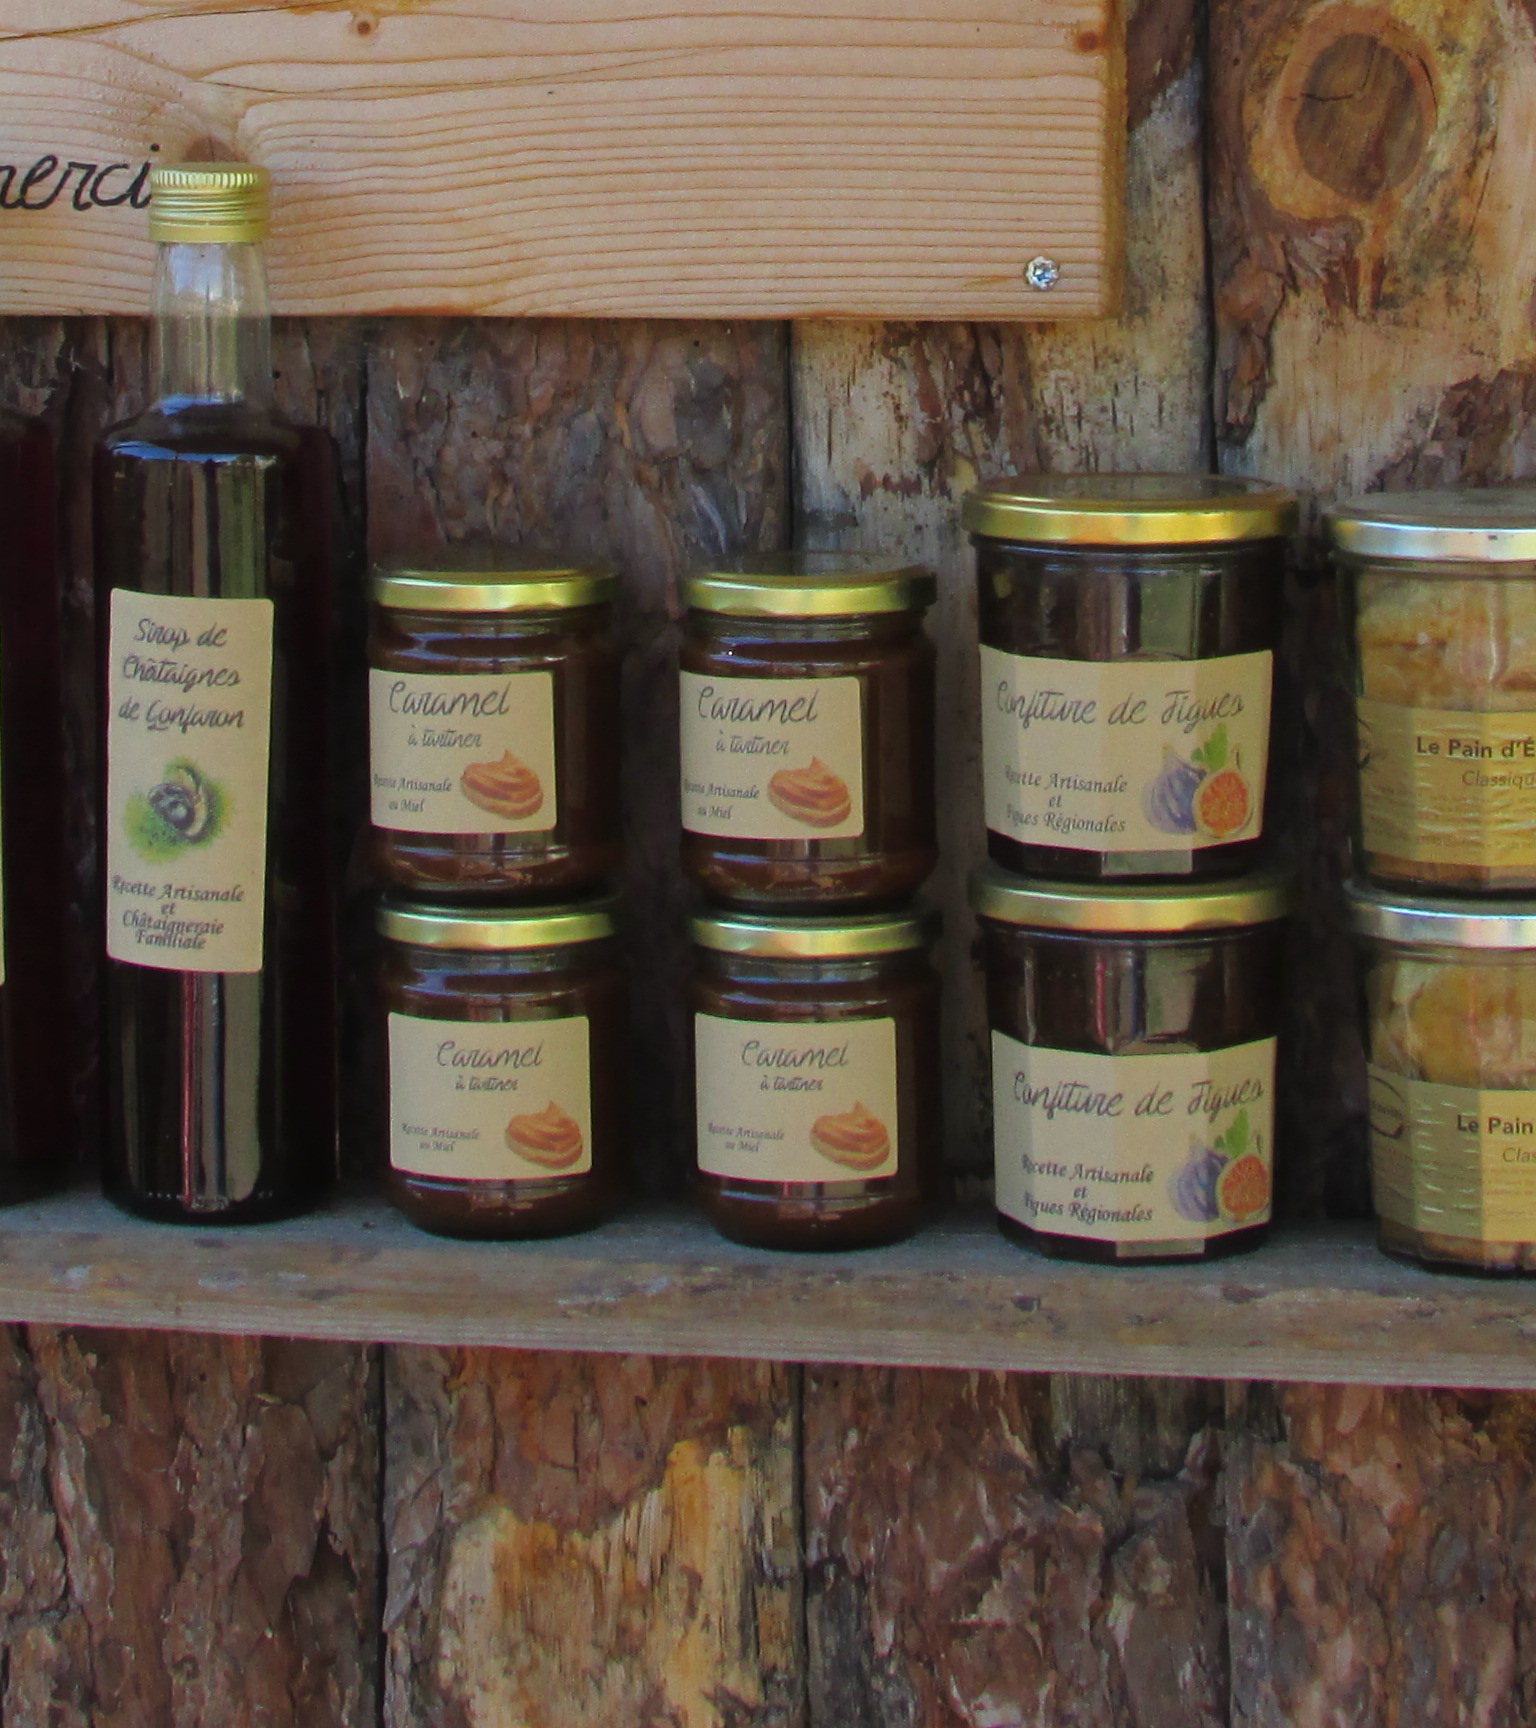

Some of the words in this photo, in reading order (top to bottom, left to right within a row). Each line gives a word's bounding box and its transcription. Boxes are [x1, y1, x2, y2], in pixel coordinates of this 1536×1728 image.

[132, 618, 190, 652] Sirop
[197, 622, 228, 647] de
[389, 680, 513, 718] Caramel
[698, 685, 820, 725] Caramel
[996, 680, 1098, 730] Confiture
[1107, 691, 1148, 726] de
[1160, 689, 1245, 734] Figues
[1416, 735, 1440, 756] Le
[1448, 738, 1492, 759] Pain
[1047, 770, 1128, 794] Artisanale
[436, 1039, 545, 1069] Caramel
[741, 1039, 850, 1069] Caramel
[1013, 1070, 1124, 1121] Confiture
[1134, 1080, 1174, 1117] de
[1457, 1113, 1479, 1134] Le
[1488, 1116, 1533, 1135] Pain
